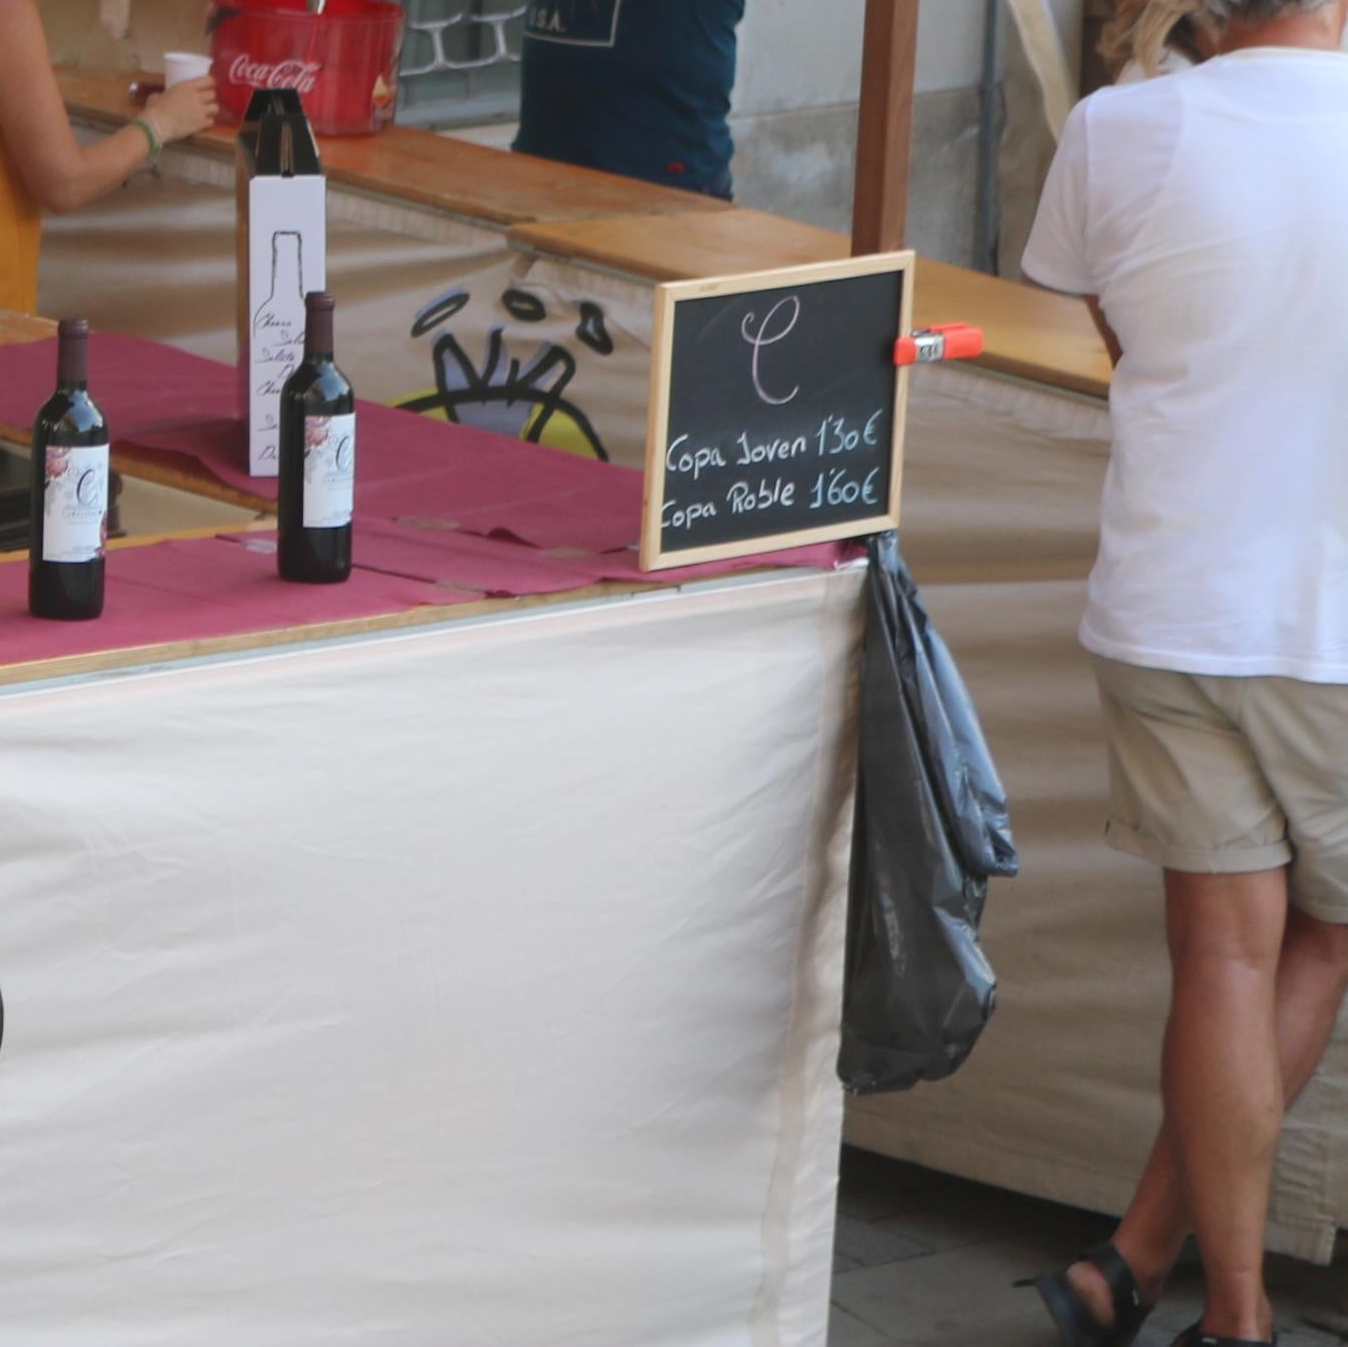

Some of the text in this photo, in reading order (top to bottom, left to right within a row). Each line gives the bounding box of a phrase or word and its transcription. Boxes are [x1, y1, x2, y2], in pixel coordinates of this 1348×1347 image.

[229, 54, 322, 93] Coca-Cola
[666, 434, 726, 480] Copa
[737, 432, 806, 465] Joven
[660, 500, 717, 530] Copa
[726, 478, 795, 514] Roble
